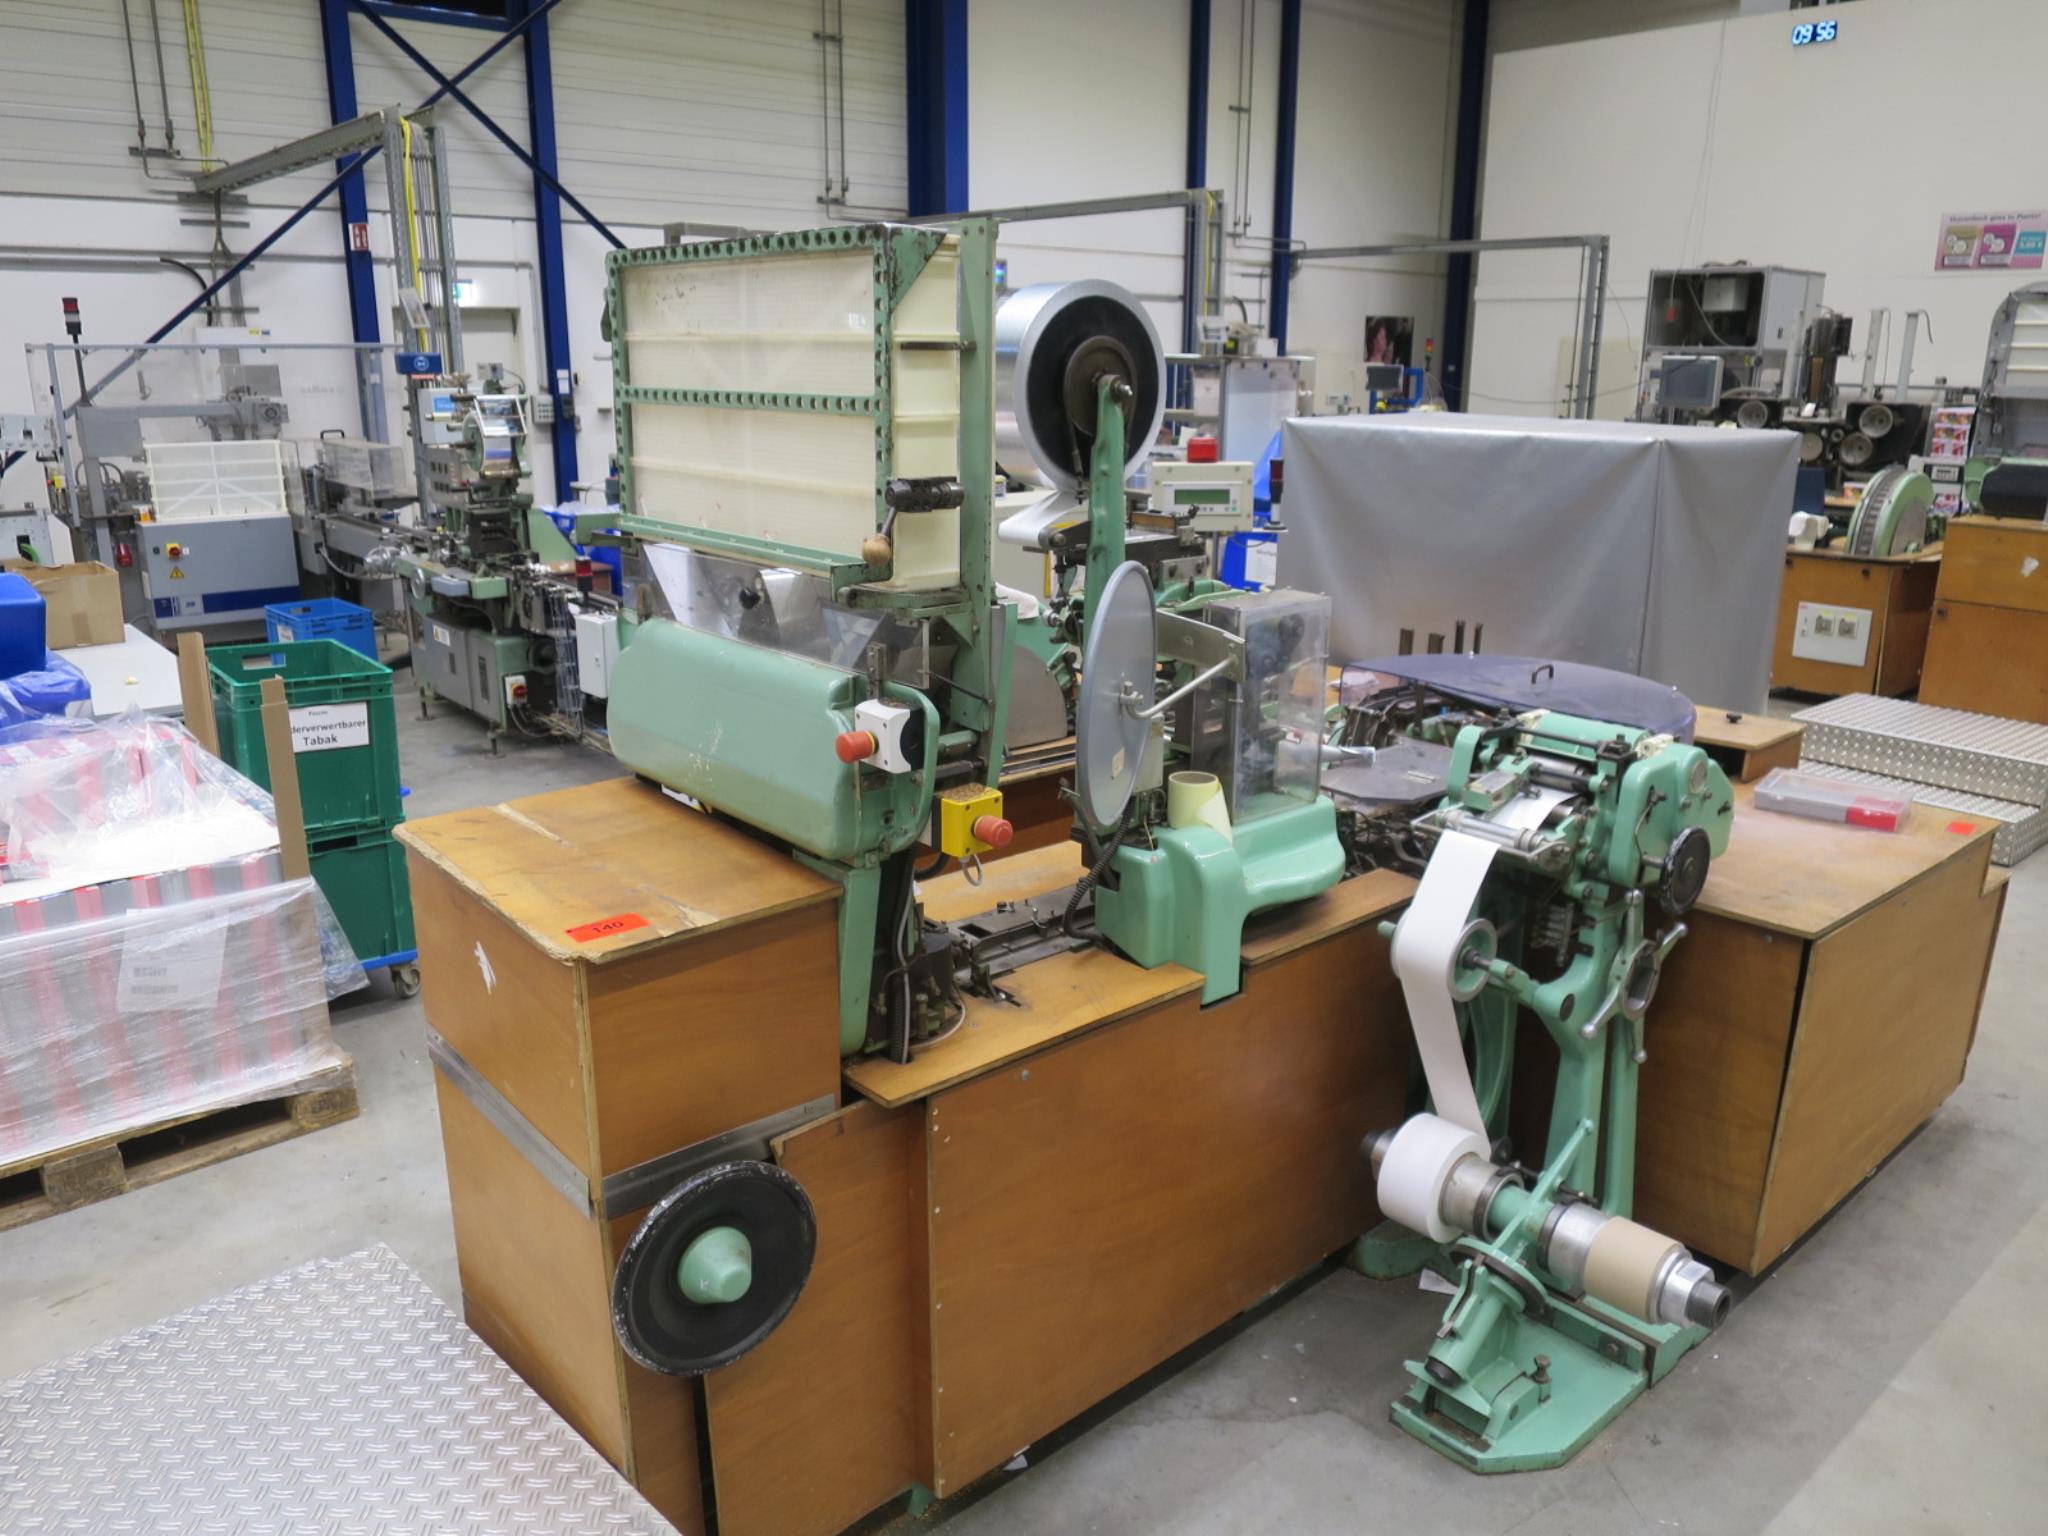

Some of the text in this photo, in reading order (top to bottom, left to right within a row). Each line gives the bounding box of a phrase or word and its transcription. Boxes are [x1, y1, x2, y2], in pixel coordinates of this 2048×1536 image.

[1792, 20, 1836, 44] 09 56
[303, 734, 338, 746] Tabak
[591, 921, 624, 933] 140
